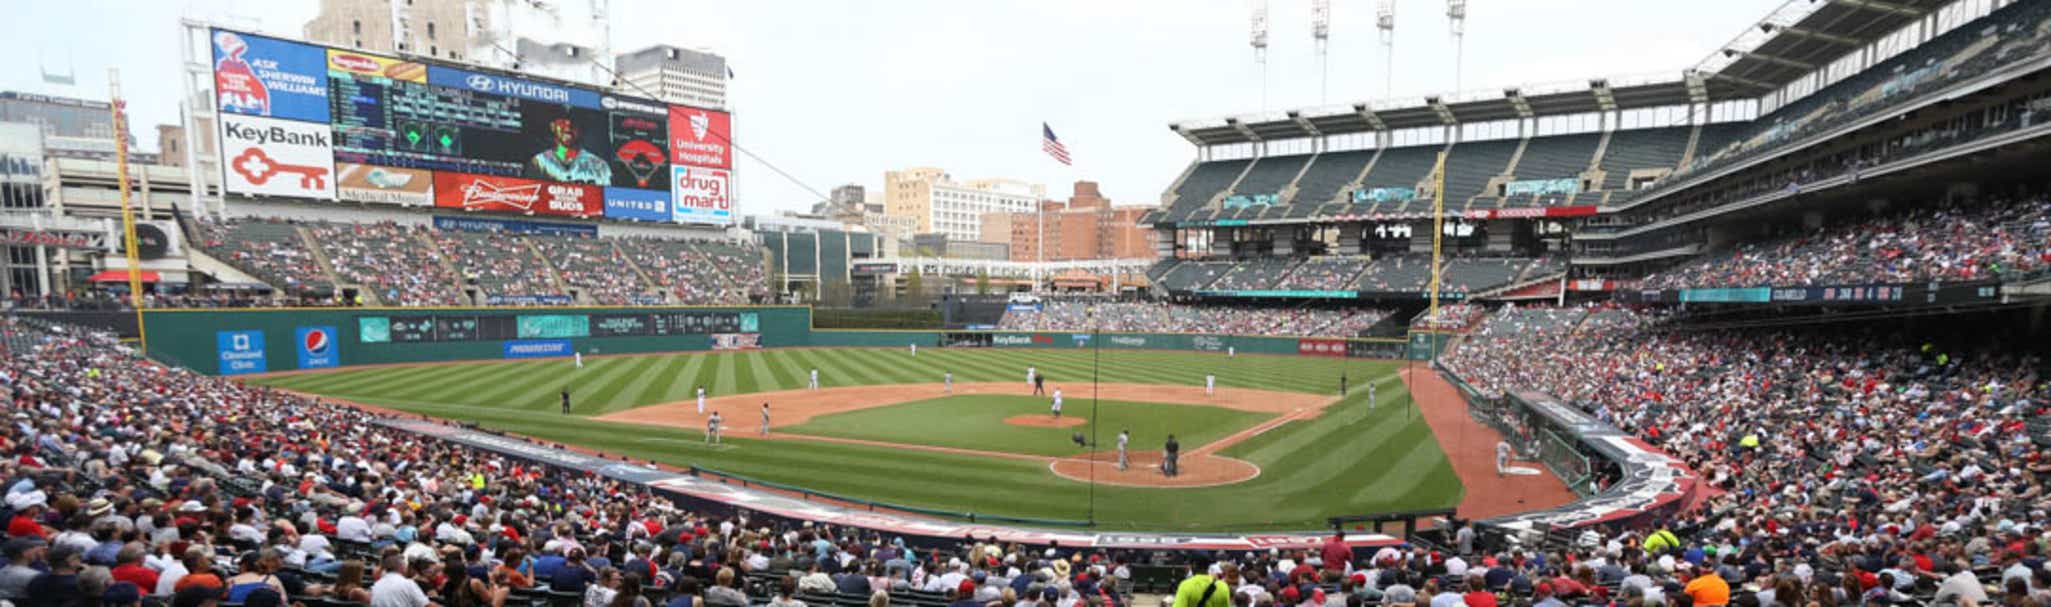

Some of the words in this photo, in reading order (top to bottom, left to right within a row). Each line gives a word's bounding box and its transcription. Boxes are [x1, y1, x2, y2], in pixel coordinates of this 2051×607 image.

[252, 58, 279, 69] ASK
[258, 69, 317, 85] SHERWIN
[267, 80, 327, 96] WILLIAMS
[498, 79, 569, 102] HYUNDAI
[224, 121, 329, 148] KeyBank
[677, 139, 724, 155] University
[678, 151, 723, 165] Hospitals
[680, 167, 720, 196] drug
[461, 183, 539, 201] Budweiser
[548, 185, 584, 197] GRAB
[549, 200, 584, 211] BUDS
[607, 198, 653, 210] UNITED
[684, 194, 729, 210] mart
[992, 335, 1033, 346] KeyBank
[222, 349, 263, 360] Cleveland
